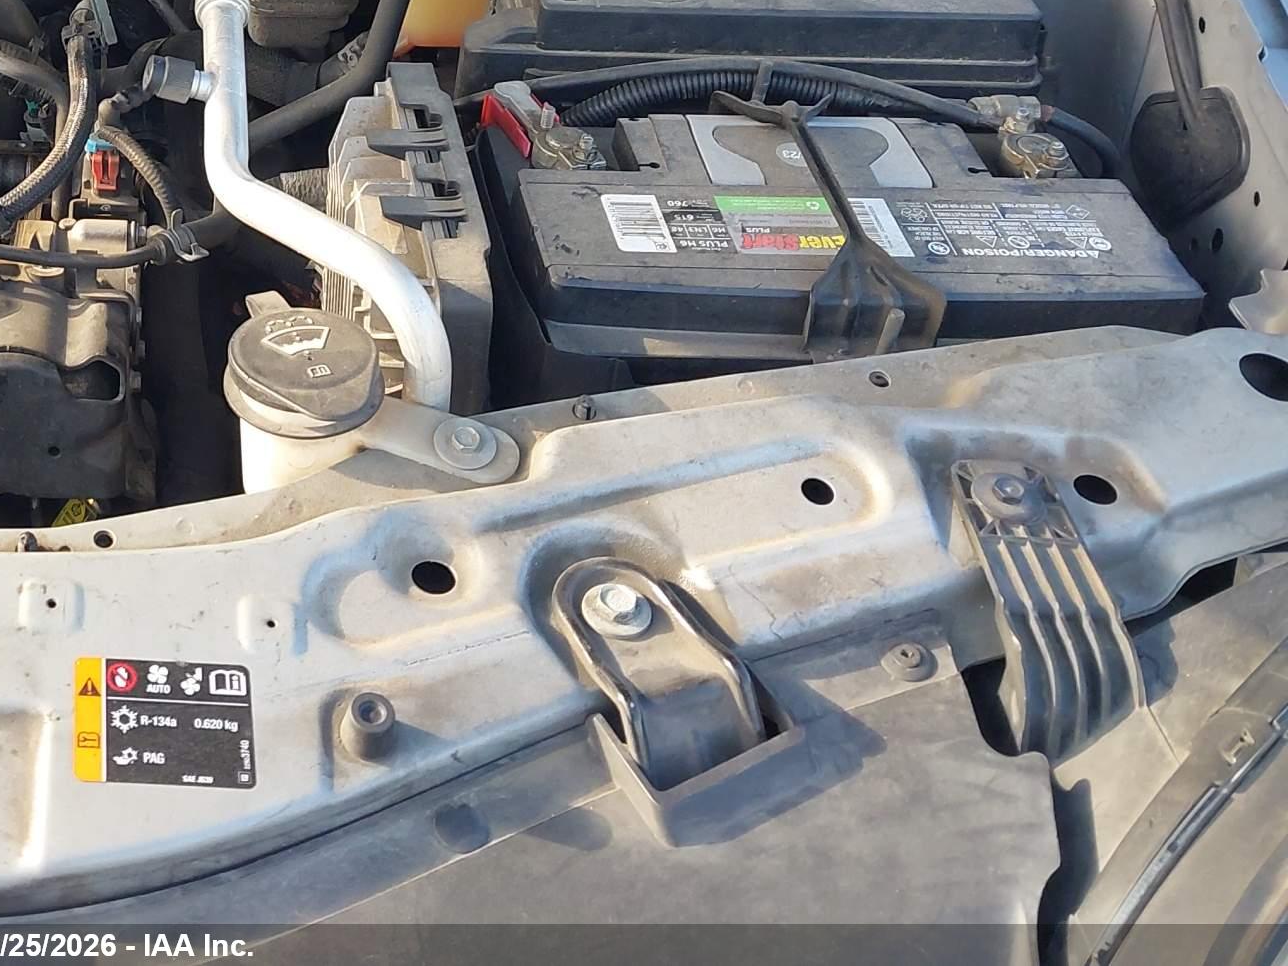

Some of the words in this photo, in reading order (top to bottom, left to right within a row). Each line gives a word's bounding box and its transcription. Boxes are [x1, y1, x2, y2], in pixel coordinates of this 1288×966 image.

[667, 199, 689, 207] 760
[698, 240, 729, 248] PLUS
[961, 248, 1089, 258] DANGER/POISON
[146, 684, 171, 694] AUTO
[140, 715, 177, 728] R-134a
[194, 718, 223, 730] 0.620
[224, 719, 239, 732] kg
[143, 752, 165, 764] PAG
